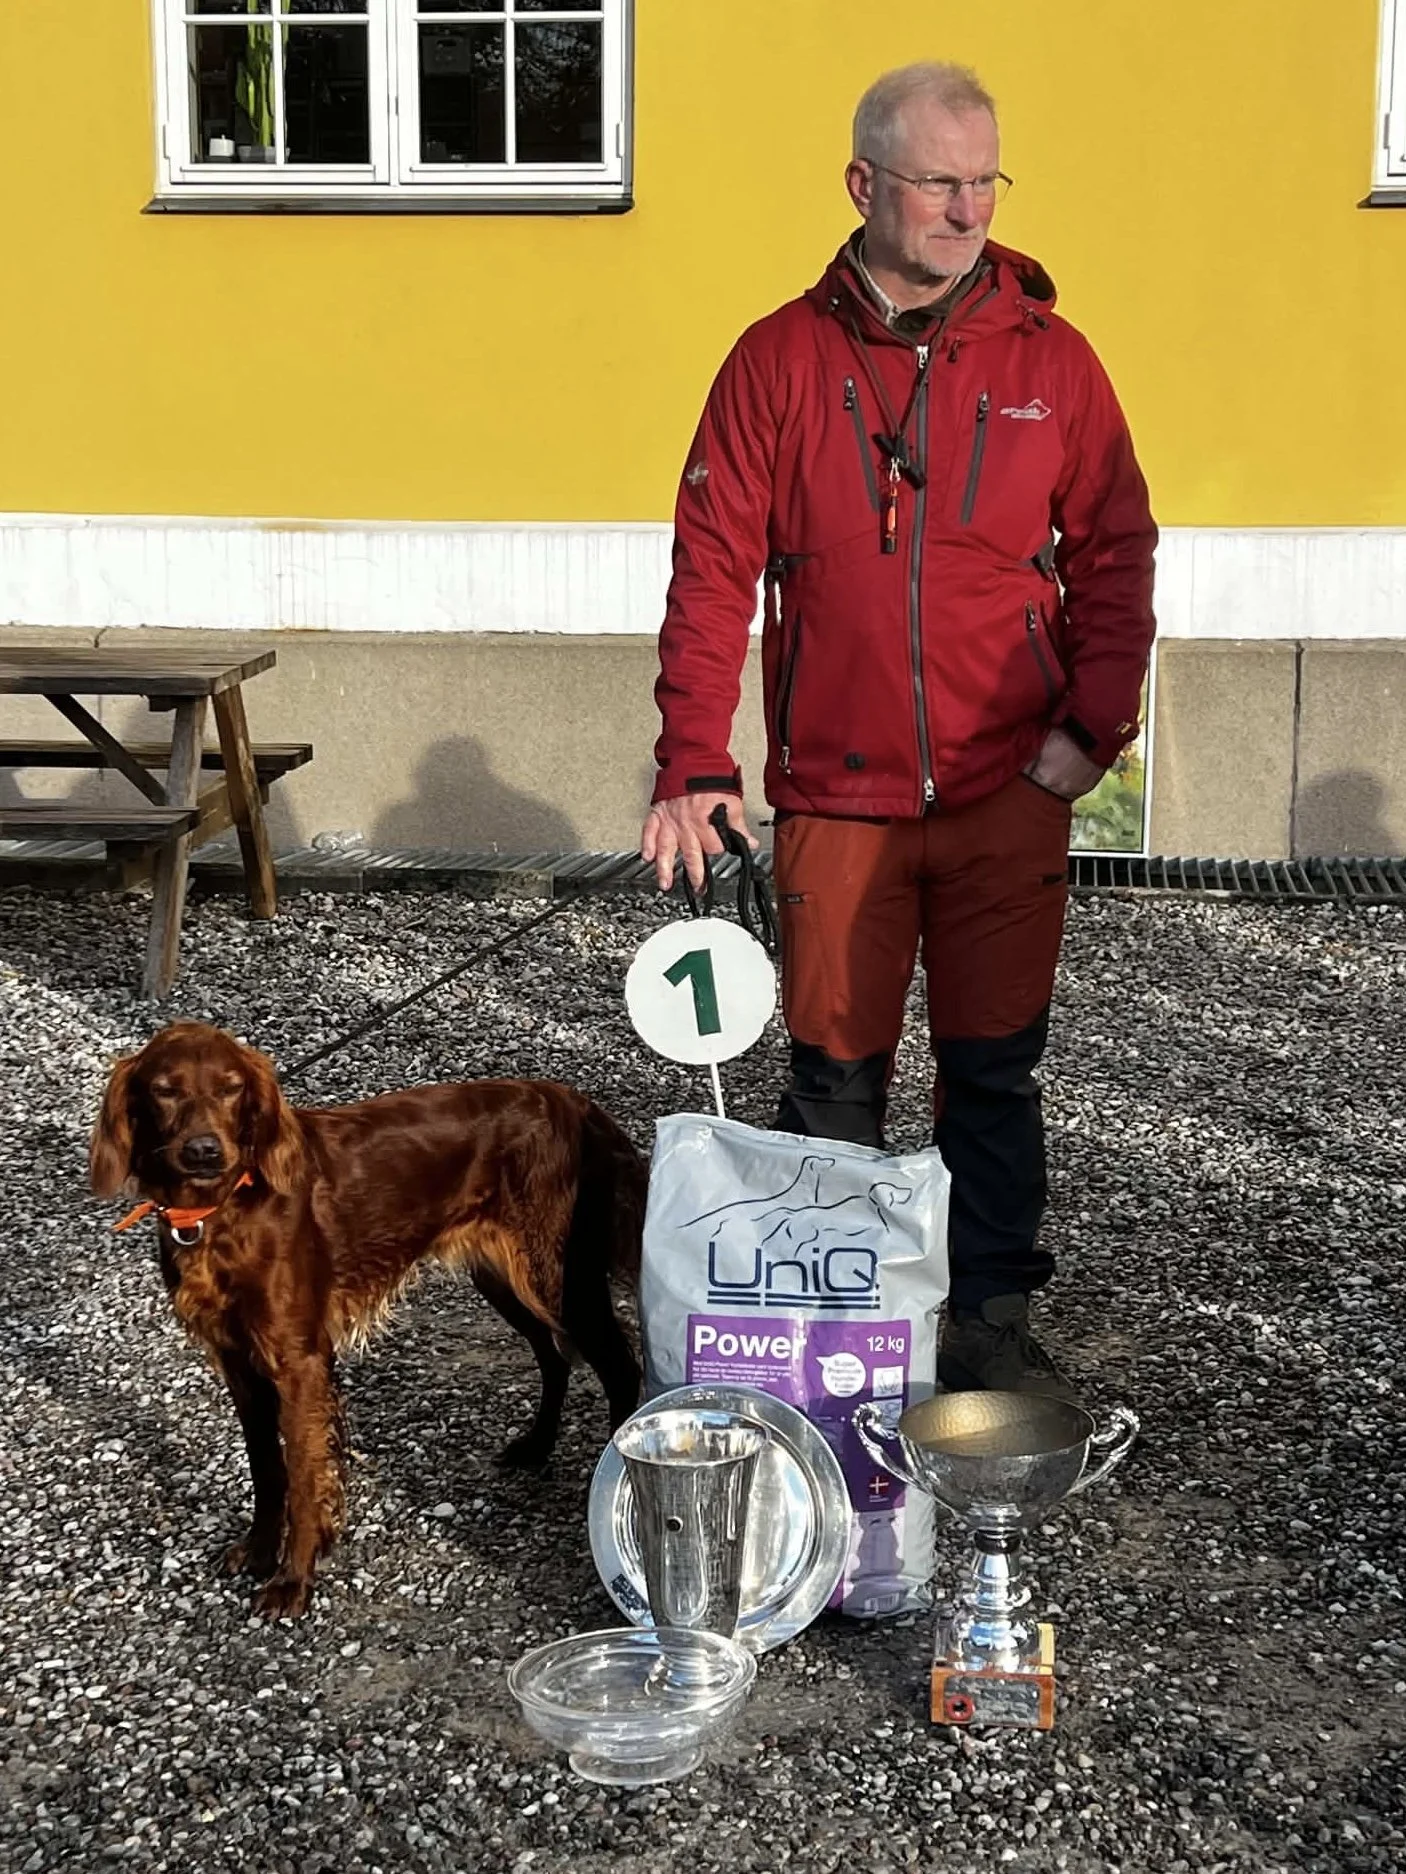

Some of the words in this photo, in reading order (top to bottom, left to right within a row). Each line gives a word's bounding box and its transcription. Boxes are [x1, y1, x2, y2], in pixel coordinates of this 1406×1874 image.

[663, 948, 722, 1036] 1
[707, 1240, 879, 1293] UniQ
[693, 1324, 807, 1359] Power
[867, 1336, 884, 1351] 12
[887, 1336, 904, 1354] kg
